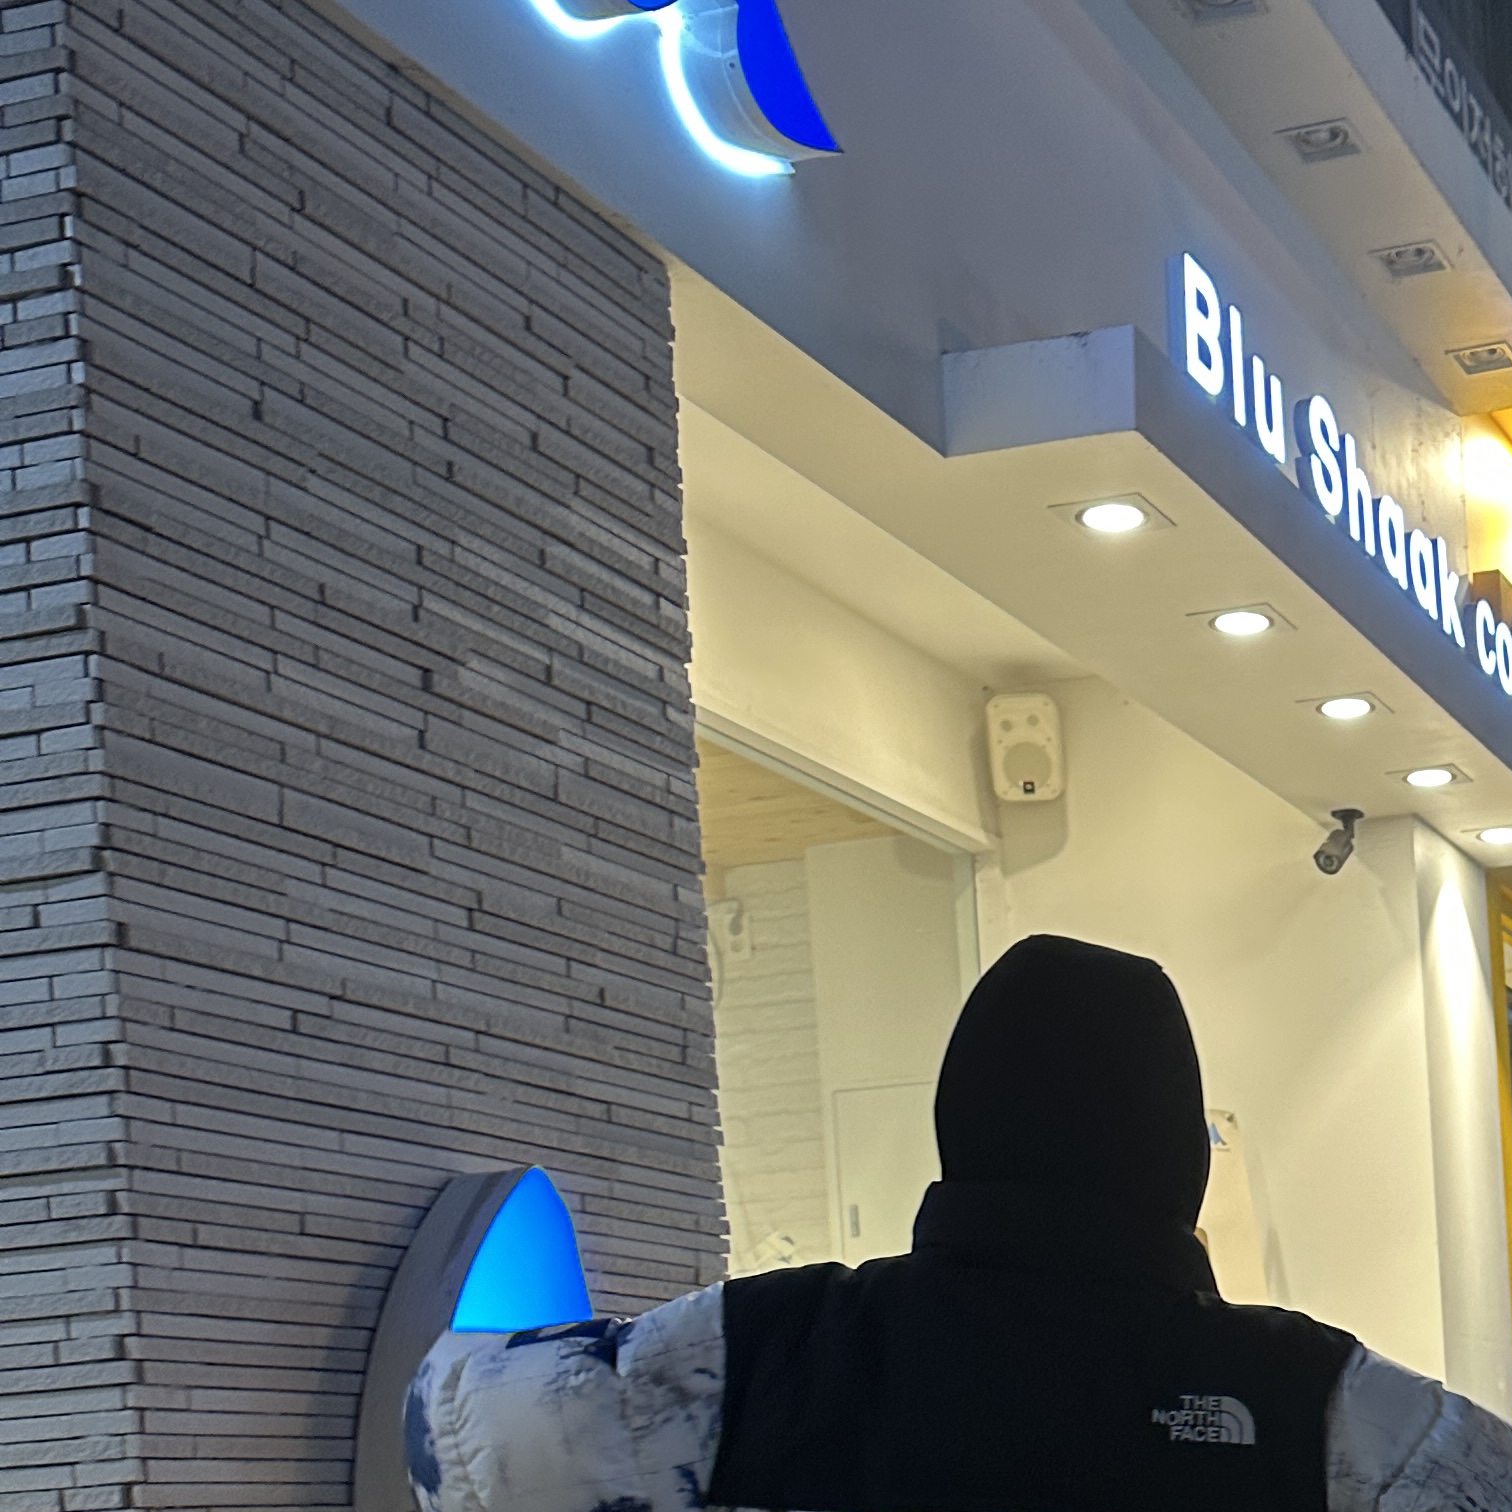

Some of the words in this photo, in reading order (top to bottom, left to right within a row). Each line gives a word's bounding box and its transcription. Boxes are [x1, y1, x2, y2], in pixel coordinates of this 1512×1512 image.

[1183, 252, 1285, 464] Blu
[1307, 394, 1466, 648] Shaak
[1179, 1395, 1221, 1411] THE
[1151, 1408, 1221, 1426] NORTH
[1170, 1425, 1221, 1442] FACE
